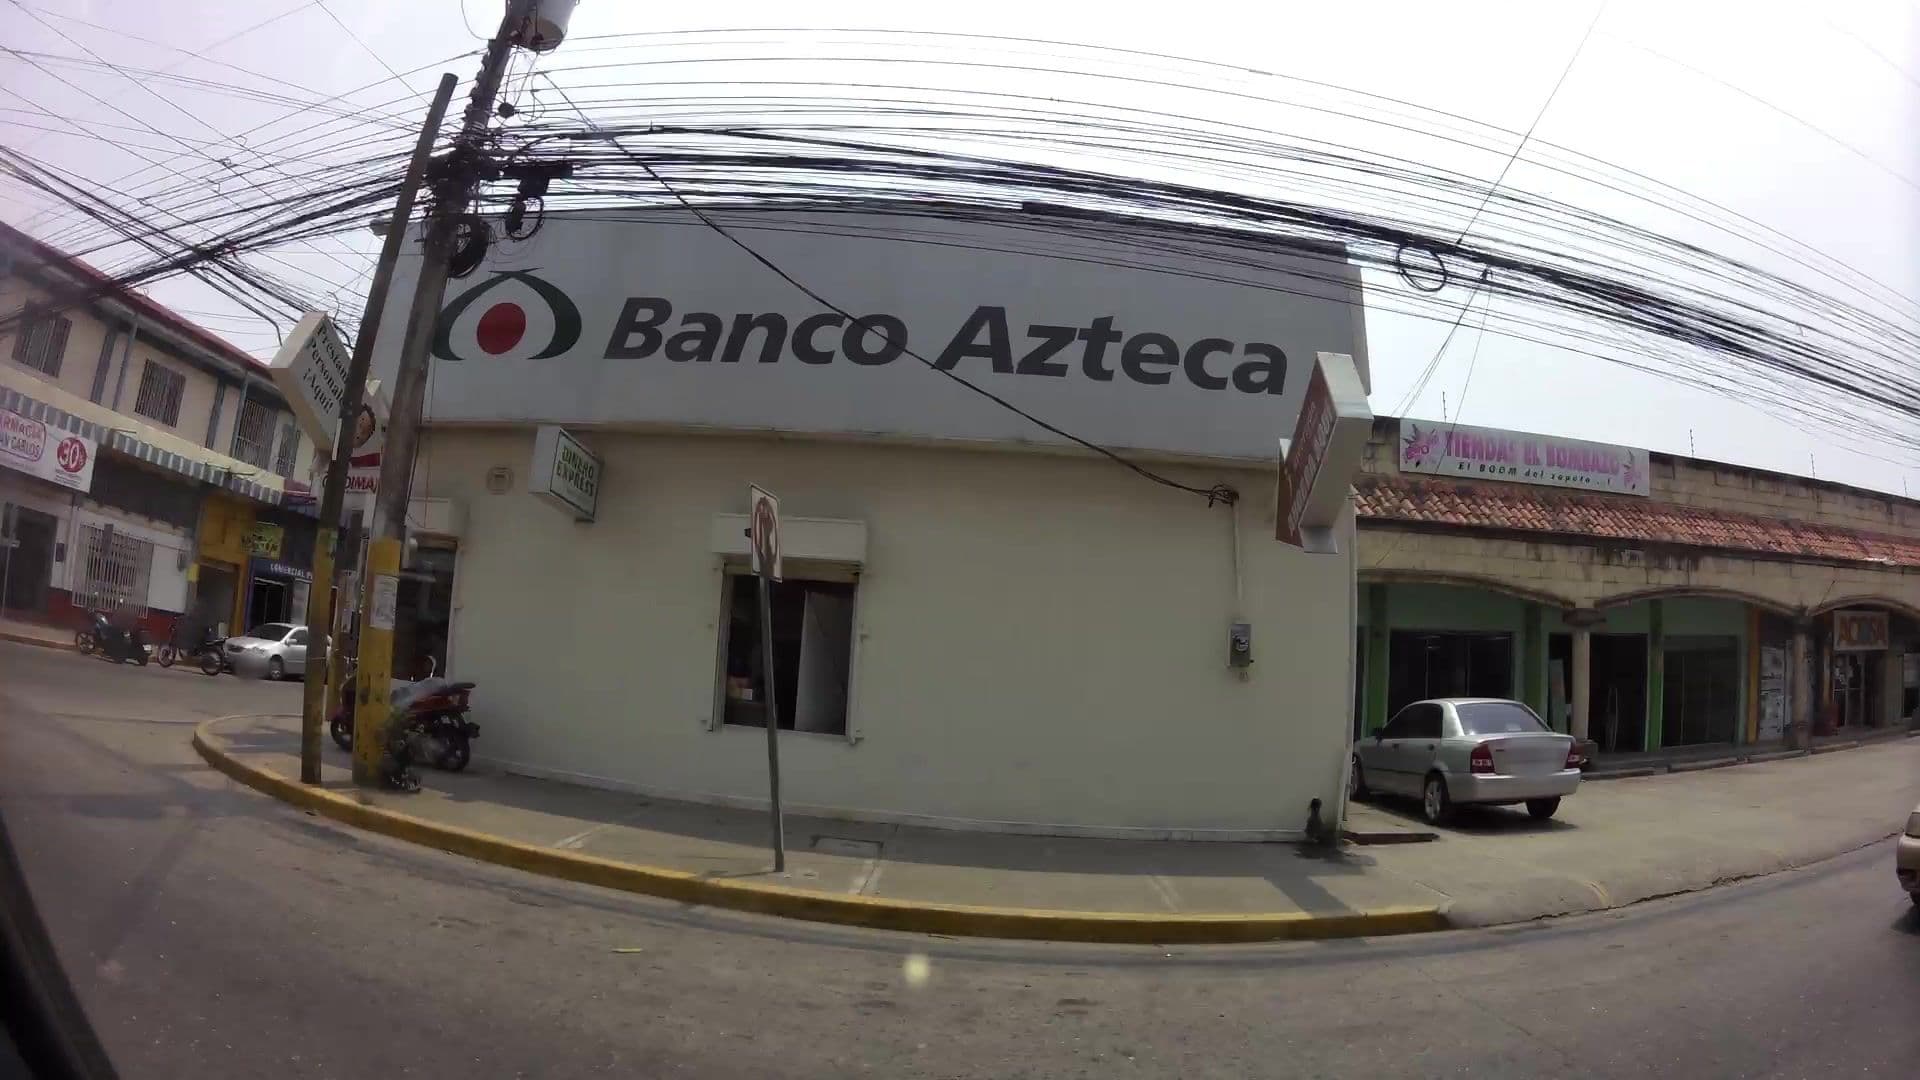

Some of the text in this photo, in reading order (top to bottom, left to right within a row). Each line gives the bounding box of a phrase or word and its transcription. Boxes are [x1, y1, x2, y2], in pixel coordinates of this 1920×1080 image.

[306, 337, 347, 404] Personal
[602, 297, 1287, 395] Banco Azteca
[1479, 463, 1517, 476] BOOM
